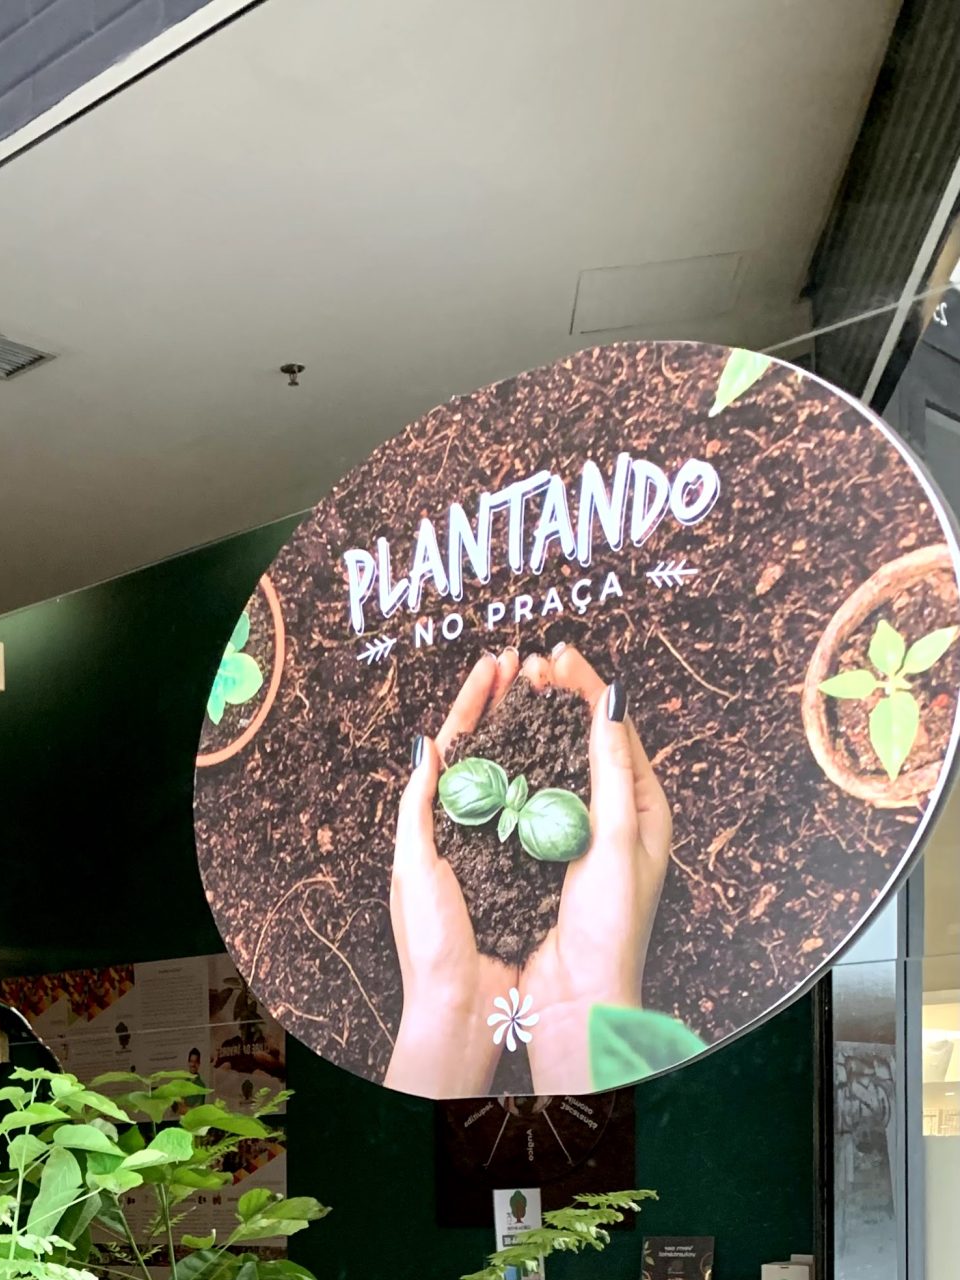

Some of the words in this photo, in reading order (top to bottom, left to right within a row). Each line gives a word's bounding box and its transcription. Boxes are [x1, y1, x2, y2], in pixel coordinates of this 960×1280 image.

[343, 451, 721, 634] PLANTANDO
[413, 615, 465, 649] NO
[487, 571, 624, 630] PRAÇA
